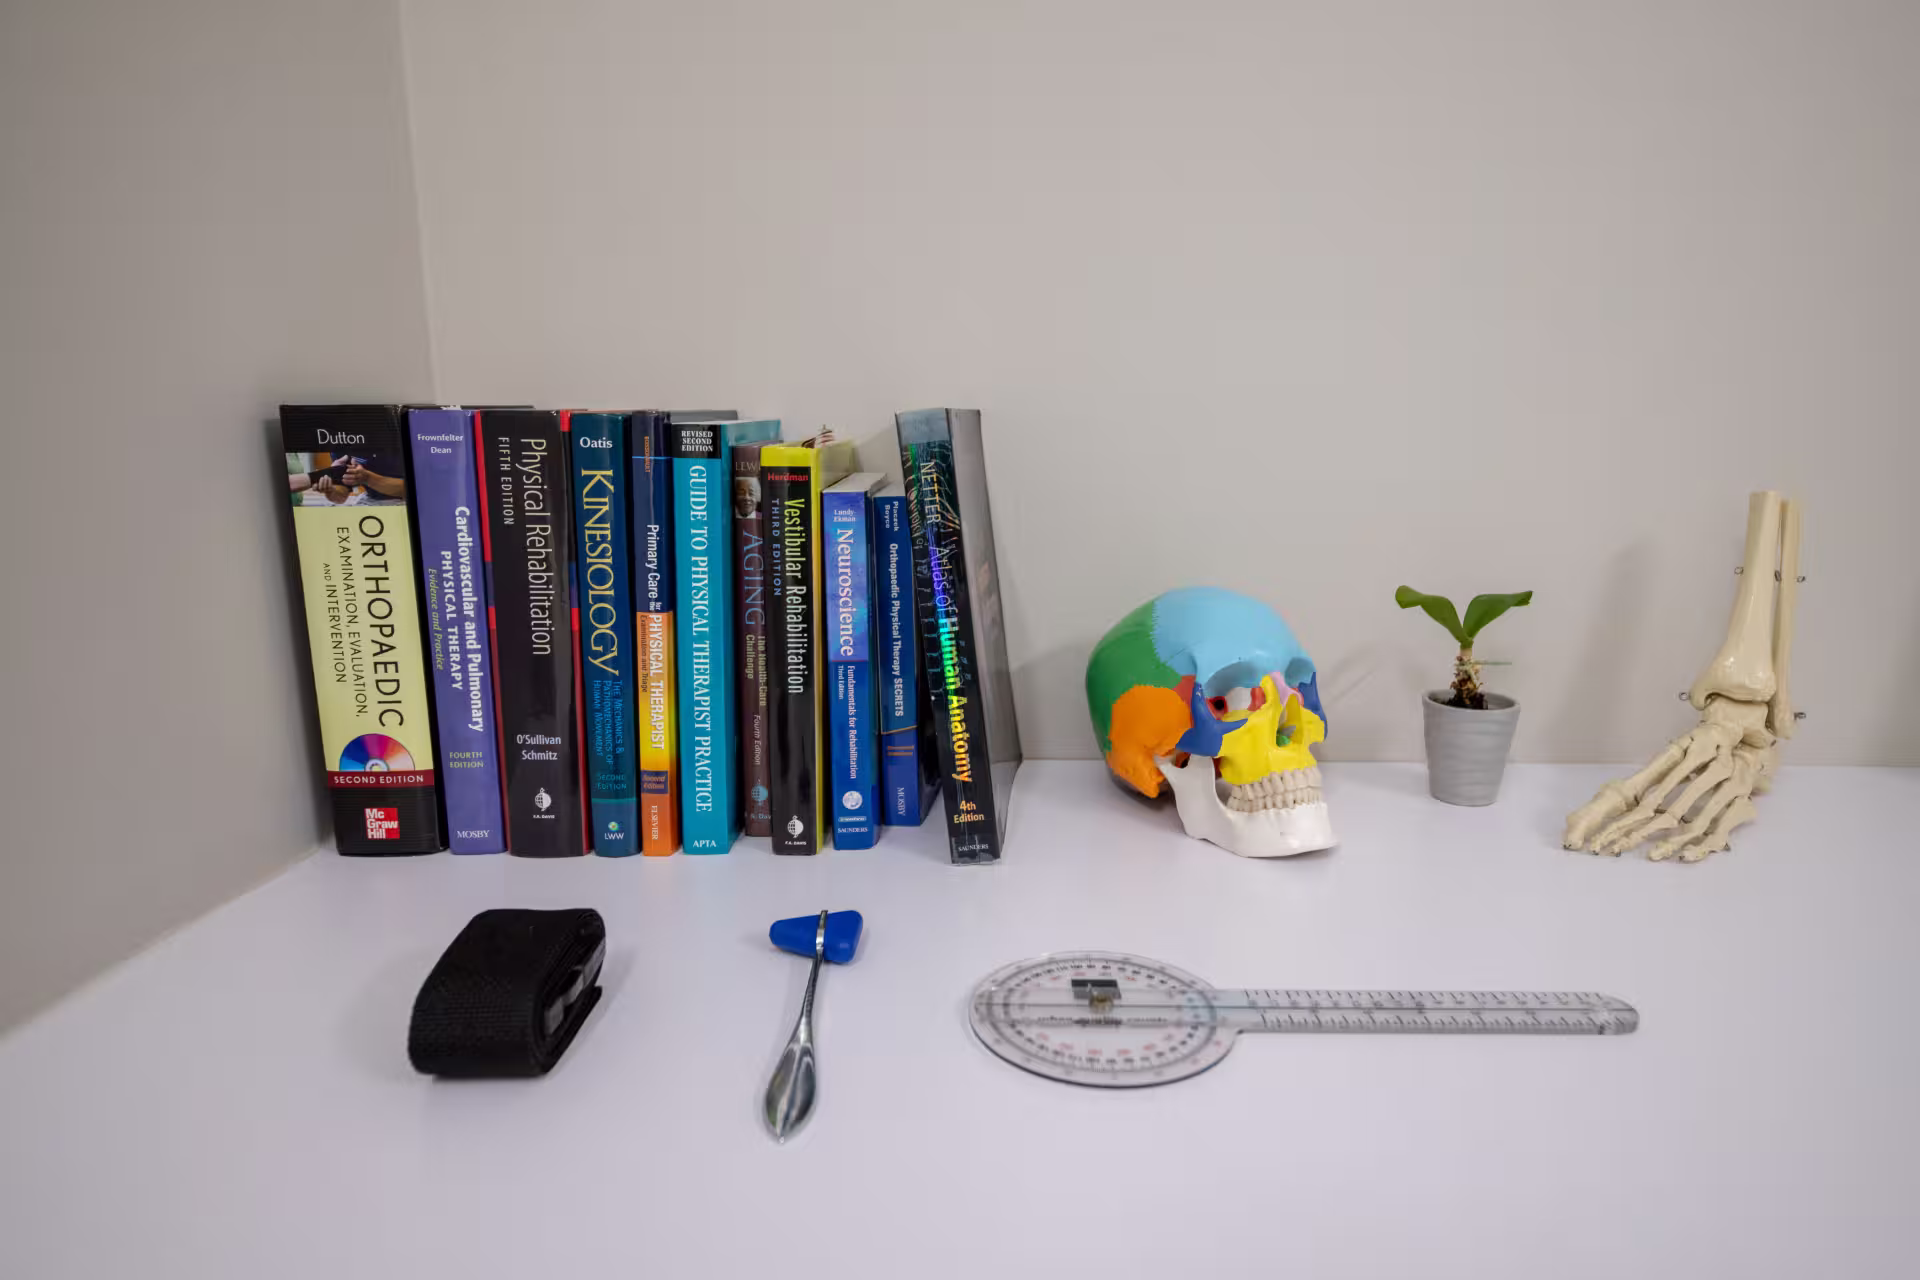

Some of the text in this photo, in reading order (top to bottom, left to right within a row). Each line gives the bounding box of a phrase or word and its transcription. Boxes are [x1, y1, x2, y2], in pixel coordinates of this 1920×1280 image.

[317, 428, 365, 445] Dutton
[417, 433, 464, 441] Frownfelter
[430, 446, 452, 454] Dean
[579, 436, 613, 449] Oatis
[681, 444, 713, 452] EDITION
[498, 437, 515, 525] FIFTH EDITION
[735, 461, 761, 471] LEW
[767, 472, 808, 481] Herdman
[920, 461, 942, 524] NETTER
[515, 438, 556, 655] Physical Rehabilitation
[645, 524, 661, 599] Primary Care
[771, 498, 782, 596] THIRD EDITION
[581, 468, 620, 676] KINESIOLOGY
[743, 530, 766, 626] AGING
[836, 528, 857, 657] Neuroscience
[783, 498, 809, 693] Vestibular Rehabilitation
[323, 562, 347, 683] AND INTERVENTION
[336, 526, 368, 718] EXAMINATION, EVALUATION,
[358, 515, 404, 728] ORTHOPAEDIC
[428, 568, 444, 671] Evidence and Practice
[440, 550, 463, 690] PHYSICAL THERAPY
[454, 506, 484, 732] Cardiovascular and Pulmonary
[640, 614, 648, 657] Examination
[689, 465, 713, 813] GUIDE TO PHYSICAL THERAPIST PRACTICE
[889, 543, 904, 717] Orthopaedic Physical Therapy SECRETS
[745, 634, 756, 679] Challenge
[757, 635, 768, 707] The Health-Care
[929, 546, 973, 782] Atlas of Human Anatomy
[613, 680, 623, 696] THE
[640, 671, 649, 693] Triage
[649, 614, 664, 750] PHYSICAL THERAPIST
[516, 734, 562, 745] O'Sullivan
[593, 680, 604, 757] HUMAN MOVEMENT
[603, 680, 614, 765] PATHOMECHANICS OF
[613, 698, 625, 744] MECHANICS
[753, 714, 762, 765] Fourth Edition
[847, 665, 858, 779] Fundamentals for Rehabilitation
[521, 750, 558, 760] Schmitz
[333, 774, 424, 784] SECOND EDITION
[897, 787, 906, 816] MOSBY
[365, 808, 385, 819] Mc
[366, 819, 399, 829] Graw
[953, 812, 985, 824] Edition
[959, 800, 977, 811] 4th
[367, 828, 386, 839] Hill
[456, 829, 490, 839] MOSBY
[604, 832, 625, 840] LWW
[692, 839, 717, 848] APTA
[958, 843, 989, 852] SAUNDERS
